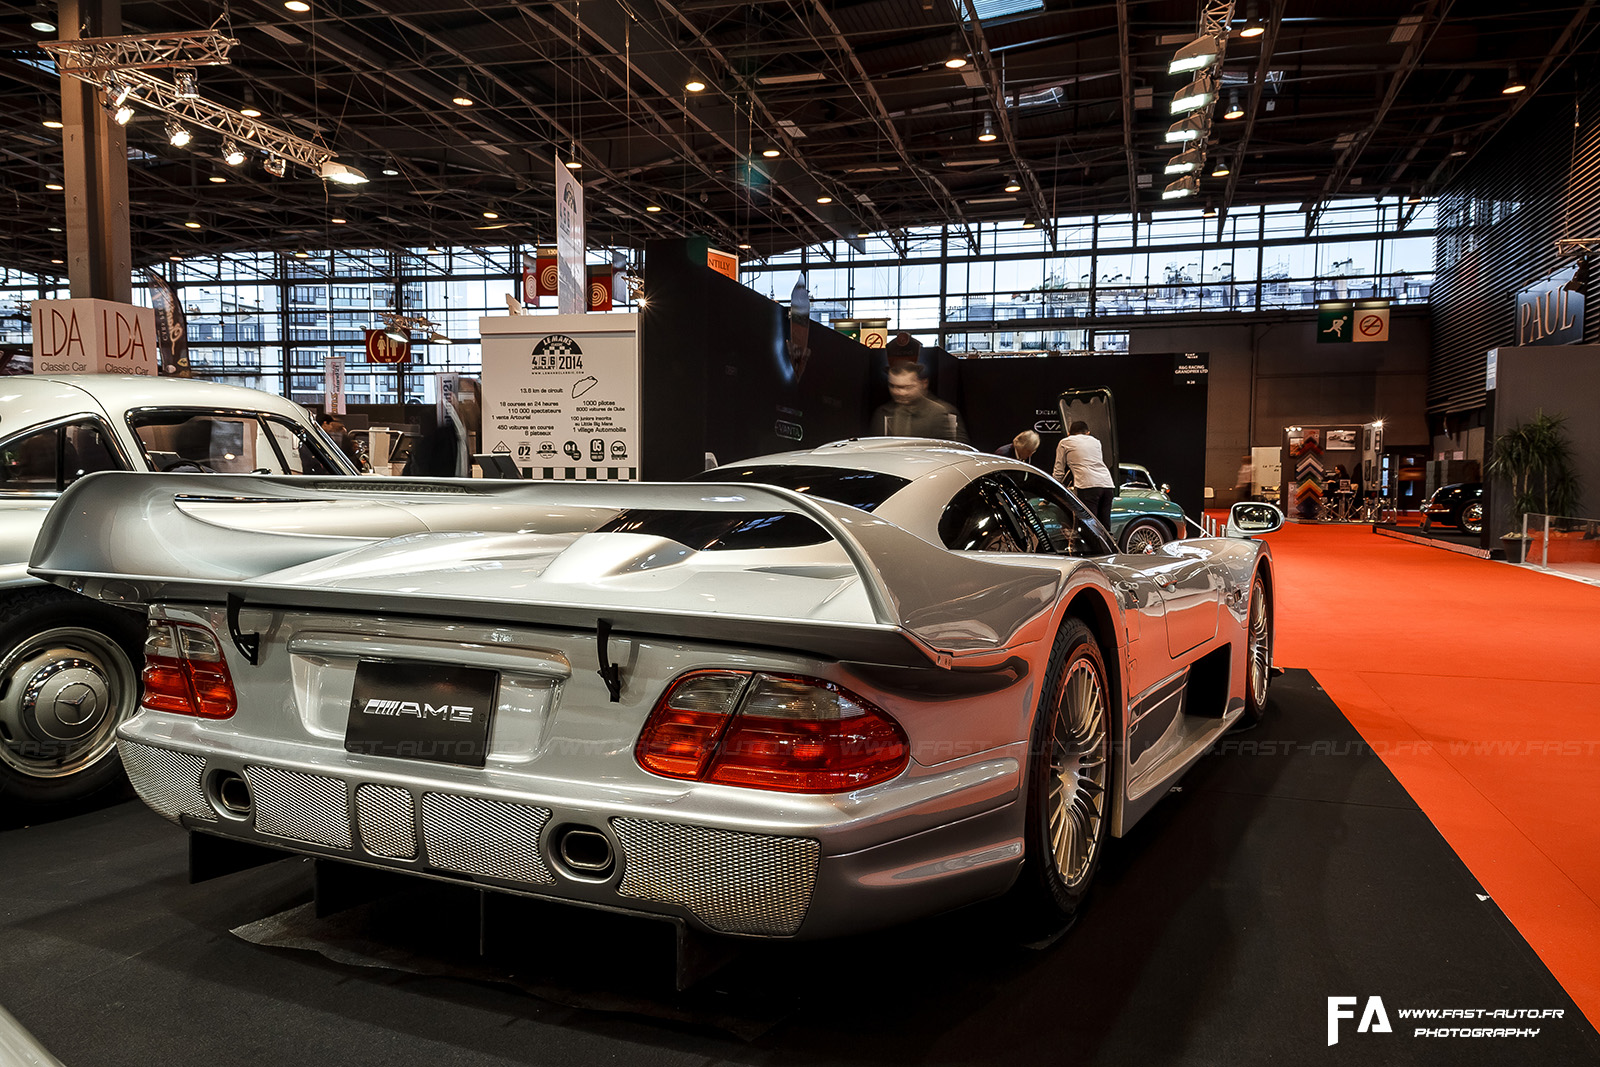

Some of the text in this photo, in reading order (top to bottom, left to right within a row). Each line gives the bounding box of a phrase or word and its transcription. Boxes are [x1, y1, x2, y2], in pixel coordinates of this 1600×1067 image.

[1519, 284, 1576, 347] PAUL
[38, 307, 86, 357] LDA
[103, 309, 148, 362] LDA
[543, 335, 573, 346] LE MANS
[40, 361, 87, 372] Classic Car
[104, 362, 149, 376] Classic Car
[558, 355, 583, 369] 2014
[518, 446, 531, 456] 02
